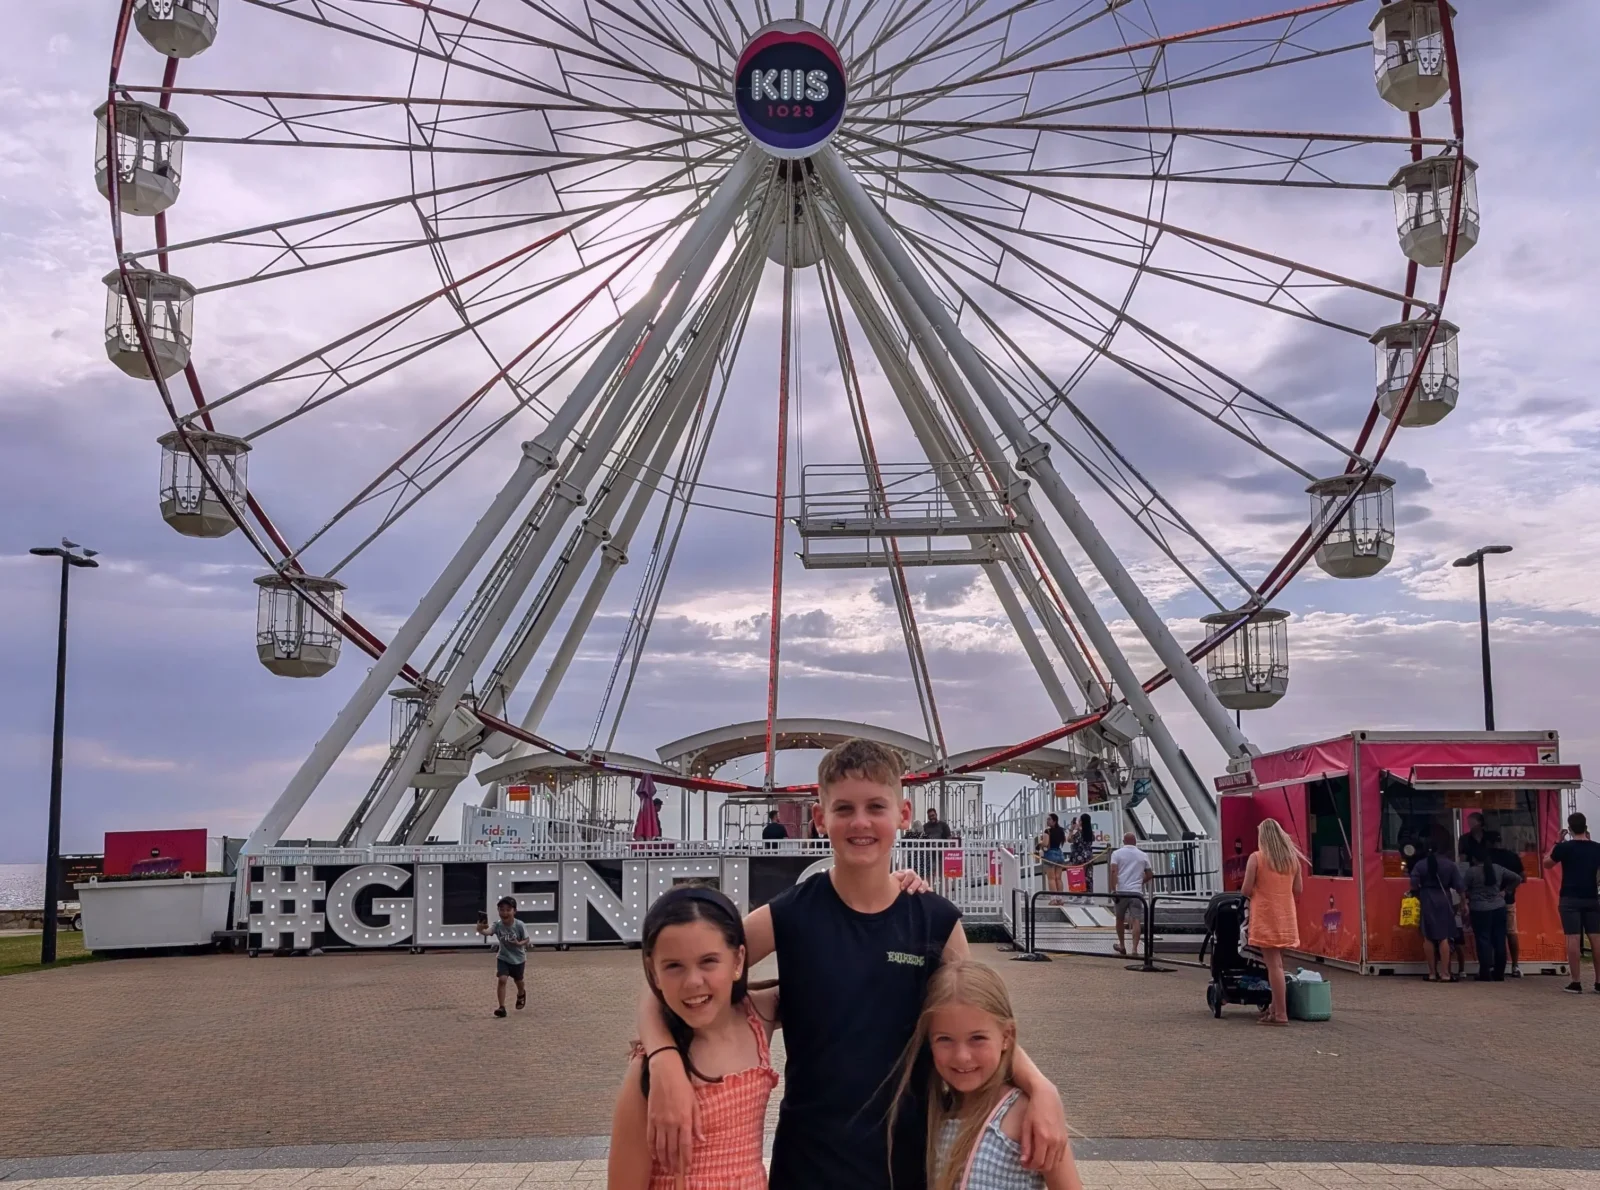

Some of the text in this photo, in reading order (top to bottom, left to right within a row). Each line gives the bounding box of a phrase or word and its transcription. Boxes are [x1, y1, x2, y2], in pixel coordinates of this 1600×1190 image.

[751, 69, 829, 101] KIIS
[767, 104, 814, 118] 1023
[1472, 766, 1526, 778] TICKETS
[481, 823, 518, 837] kids in
